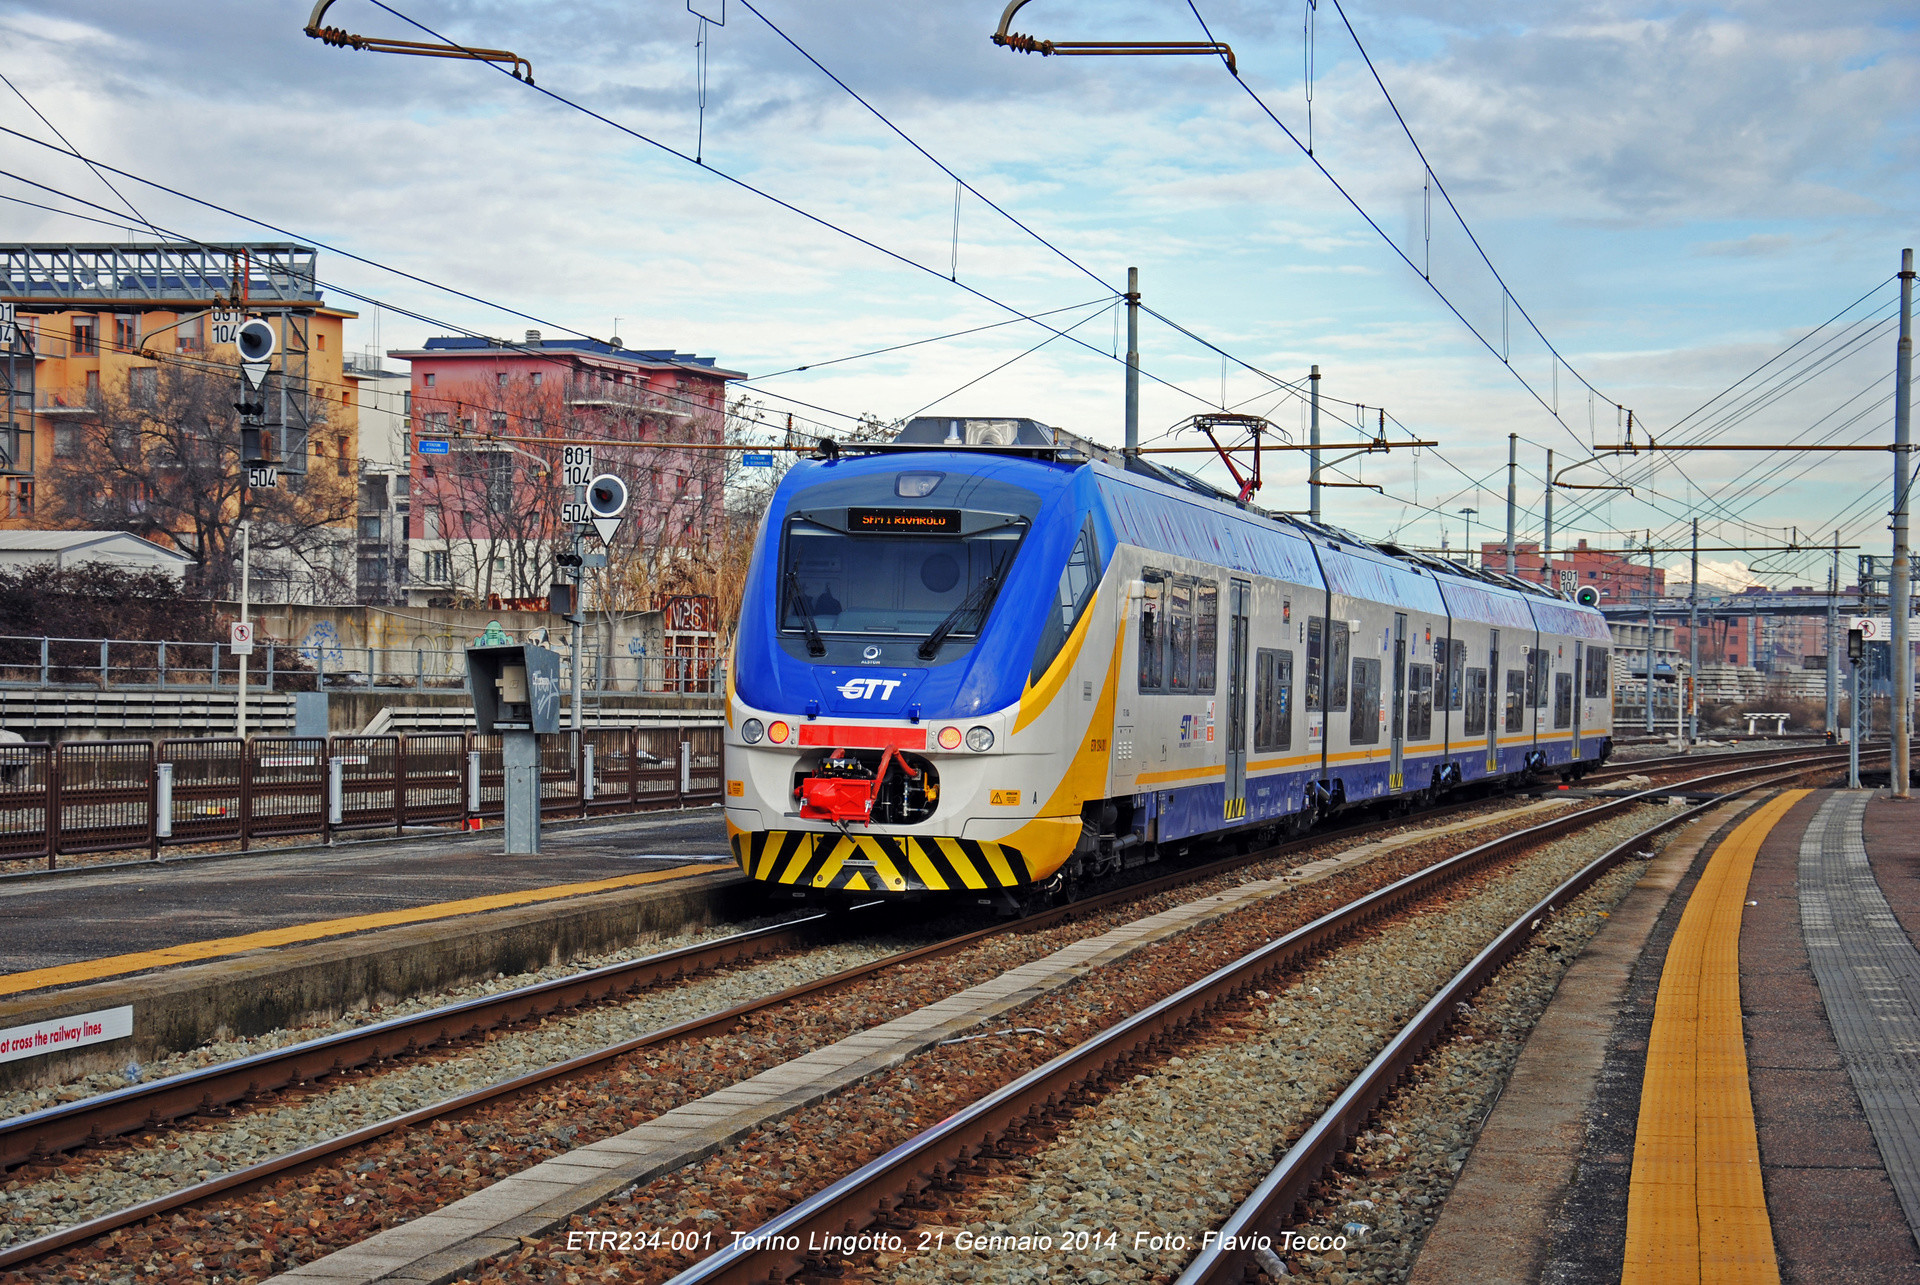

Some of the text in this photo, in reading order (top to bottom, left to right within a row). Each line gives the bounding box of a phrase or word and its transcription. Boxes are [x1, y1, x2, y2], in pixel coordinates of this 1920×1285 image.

[213, 325, 236, 343] 104
[565, 447, 591, 465] 801
[250, 469, 275, 487] 504
[565, 467, 590, 484] 104
[563, 504, 589, 522] 504
[1561, 571, 1577, 581] 801
[1561, 582, 1576, 591] 104
[836, 678, 901, 701] GTT
[11, 1036, 33, 1051] cross
[34, 1030, 48, 1046] the
[49, 1025, 82, 1043] railway
[83, 1021, 102, 1037] lines
